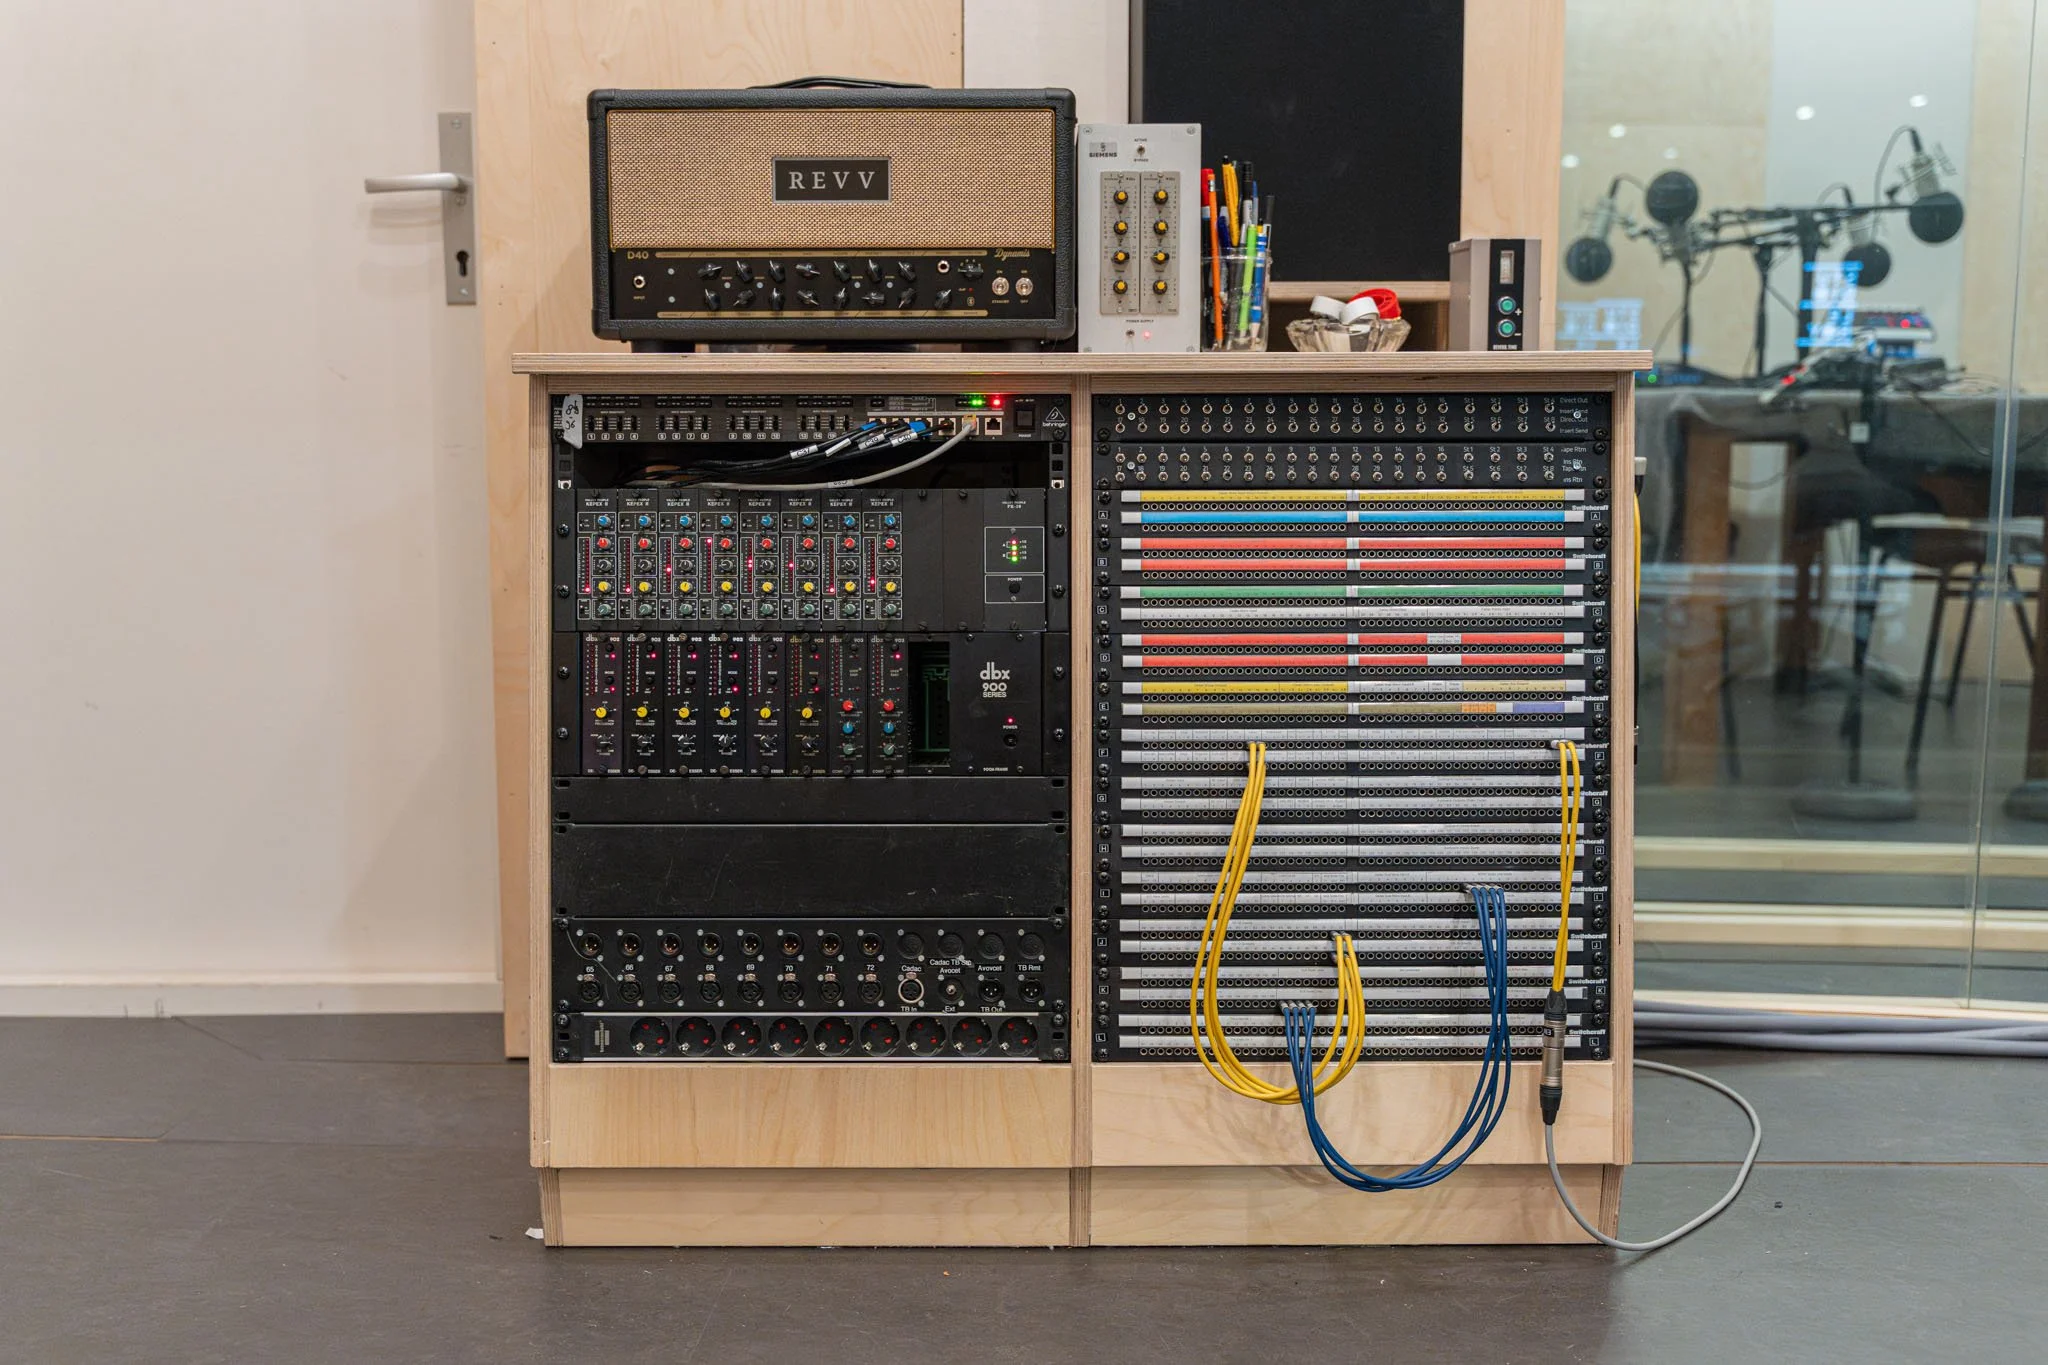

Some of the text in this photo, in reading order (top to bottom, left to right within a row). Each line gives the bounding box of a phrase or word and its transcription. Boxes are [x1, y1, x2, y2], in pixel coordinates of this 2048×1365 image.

[789, 171, 876, 189] REVV
[627, 251, 649, 260] D40
[994, 249, 1031, 261] Dynamis
[897, 434, 913, 444] C40
[667, 634, 680, 642] dbx
[708, 634, 721, 642] dbx
[748, 634, 761, 642] dbx
[979, 661, 1010, 680] dbx
[982, 682, 1007, 692] 900
